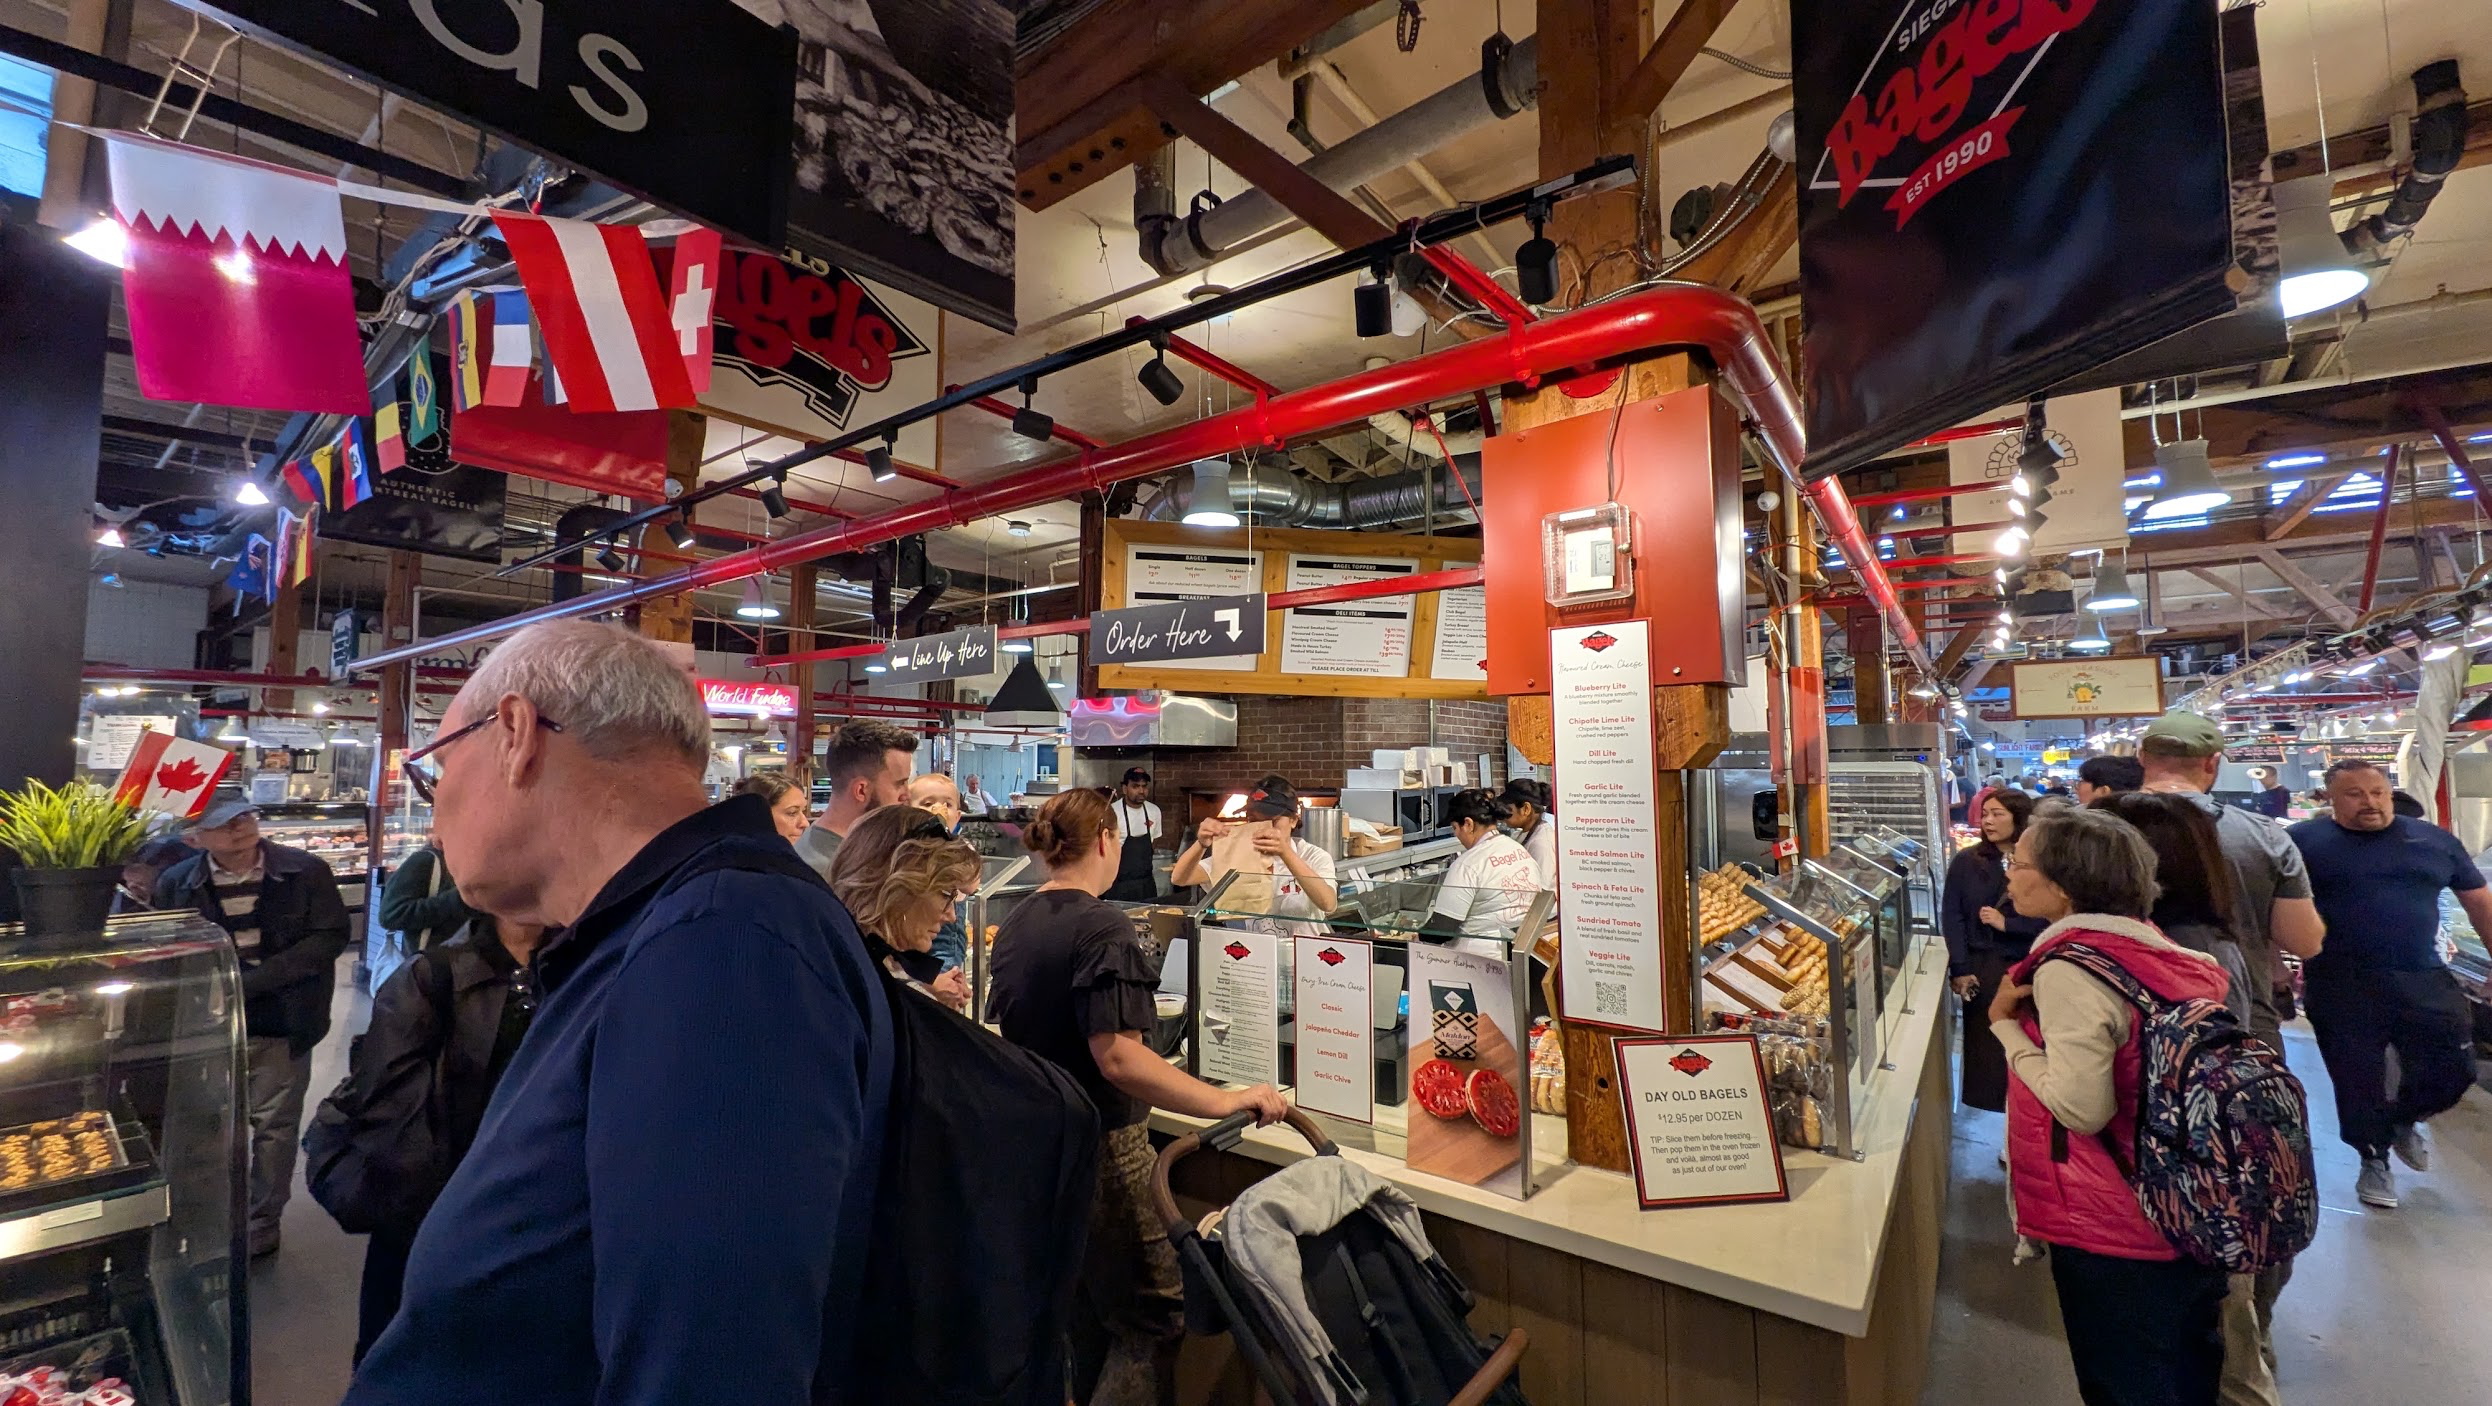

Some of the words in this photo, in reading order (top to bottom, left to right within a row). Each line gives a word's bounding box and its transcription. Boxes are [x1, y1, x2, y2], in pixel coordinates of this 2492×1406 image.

[1898, 0, 1953, 52] SIEG
[1906, 173, 1931, 203] EST
[1936, 131, 1993, 182] 1990
[380, 478, 455, 498] AUTHENTIC
[374, 486, 426, 502] NTREAL
[432, 496, 480, 512] BAGELS
[1106, 620, 1158, 654] Order
[1166, 608, 1212, 652] Here
[912, 643, 934, 670] Line
[937, 641, 954, 674] Up
[958, 633, 988, 666] Here
[1591, 661, 1614, 671] Cream
[1617, 659, 1644, 668] Cheese
[704, 683, 748, 704] World
[1575, 684, 1610, 692] Blueberry
[1569, 717, 1600, 725] Chipotle
[1576, 816, 1620, 824] Peppercorn
[1488, 850, 1518, 867] Bagel
[1572, 882, 1602, 890] Spinach
[1577, 916, 1610, 925] Sundried
[1612, 919, 1642, 928] Tomato
[1416, 951, 1424, 960] The
[1589, 950, 1614, 960] Veggie
[1616, 953, 1630, 961] Lite
[1330, 979, 1346, 988] Cream
[1348, 982, 1366, 992] Cheese
[1321, 1003, 1343, 1012] Classic
[1332, 1028, 1360, 1039] Cheddar
[1316, 1048, 1336, 1058] Lemon
[1338, 1050, 1348, 1060] Dill
[1314, 1070, 1332, 1081] Garlic
[1334, 1074, 1352, 1084] Chive
[1645, 1091, 1668, 1103] DAY
[1672, 1090, 1696, 1102] OLD
[1700, 1088, 1748, 1100] BAGELS
[1658, 1113, 1688, 1124] $12.95
[1689, 1114, 1703, 1124] per
[1706, 1111, 1743, 1122] DOZEN
[1666, 1135, 1682, 1143] Slice
[1684, 1134, 1700, 1142] them
[1702, 1134, 1724, 1142] before
[1651, 1146, 1668, 1154] Then
[1670, 1147, 1682, 1155] pop
[1666, 1156, 1679, 1164] and
[1700, 1154, 1722, 1162] almost
[1733, 1153, 1750, 1162] good
[1682, 1166, 1694, 1176] just
[1696, 1165, 1707, 1173] out
[1708, 1164, 1714, 1172] of
[1728, 1163, 1746, 1171] oven!
